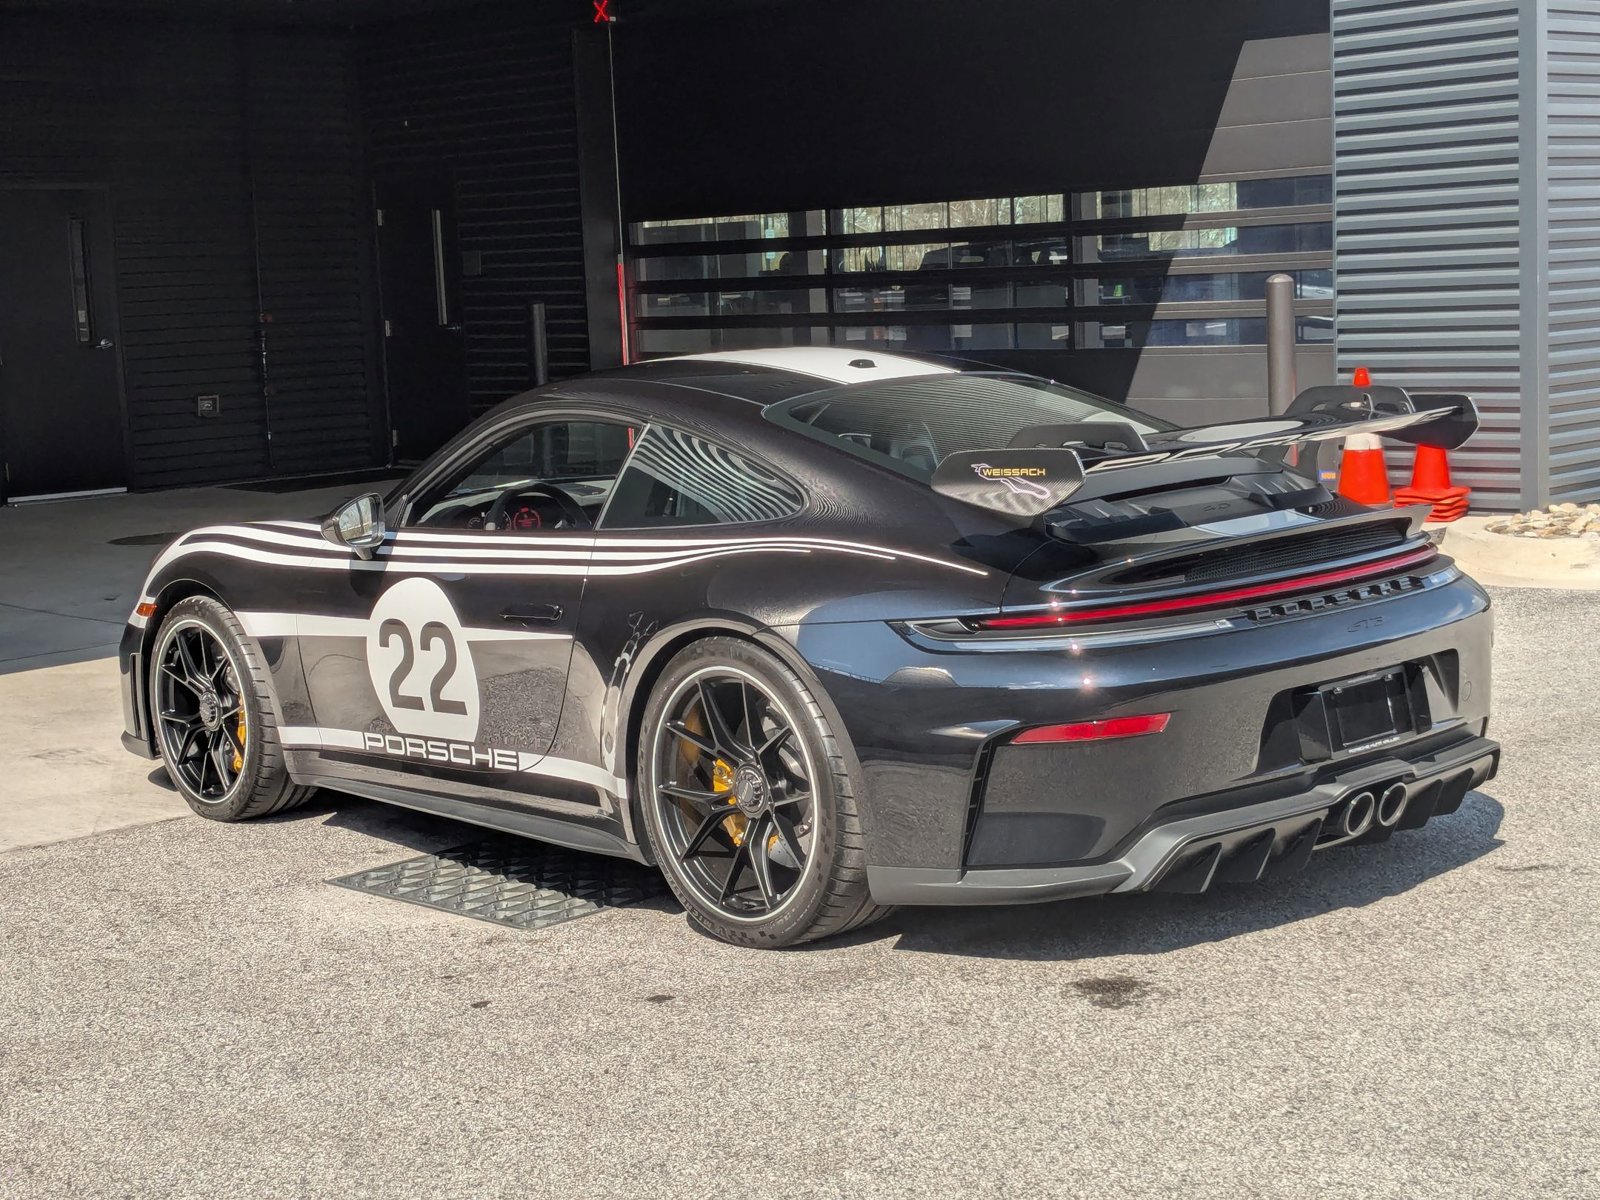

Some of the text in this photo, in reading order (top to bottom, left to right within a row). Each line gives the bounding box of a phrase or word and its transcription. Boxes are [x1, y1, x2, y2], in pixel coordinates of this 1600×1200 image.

[982, 467, 1046, 477] WEISSACH
[1252, 576, 1412, 621] PORSCHE
[379, 618, 468, 715] 22
[363, 732, 520, 771] PORSCHE
